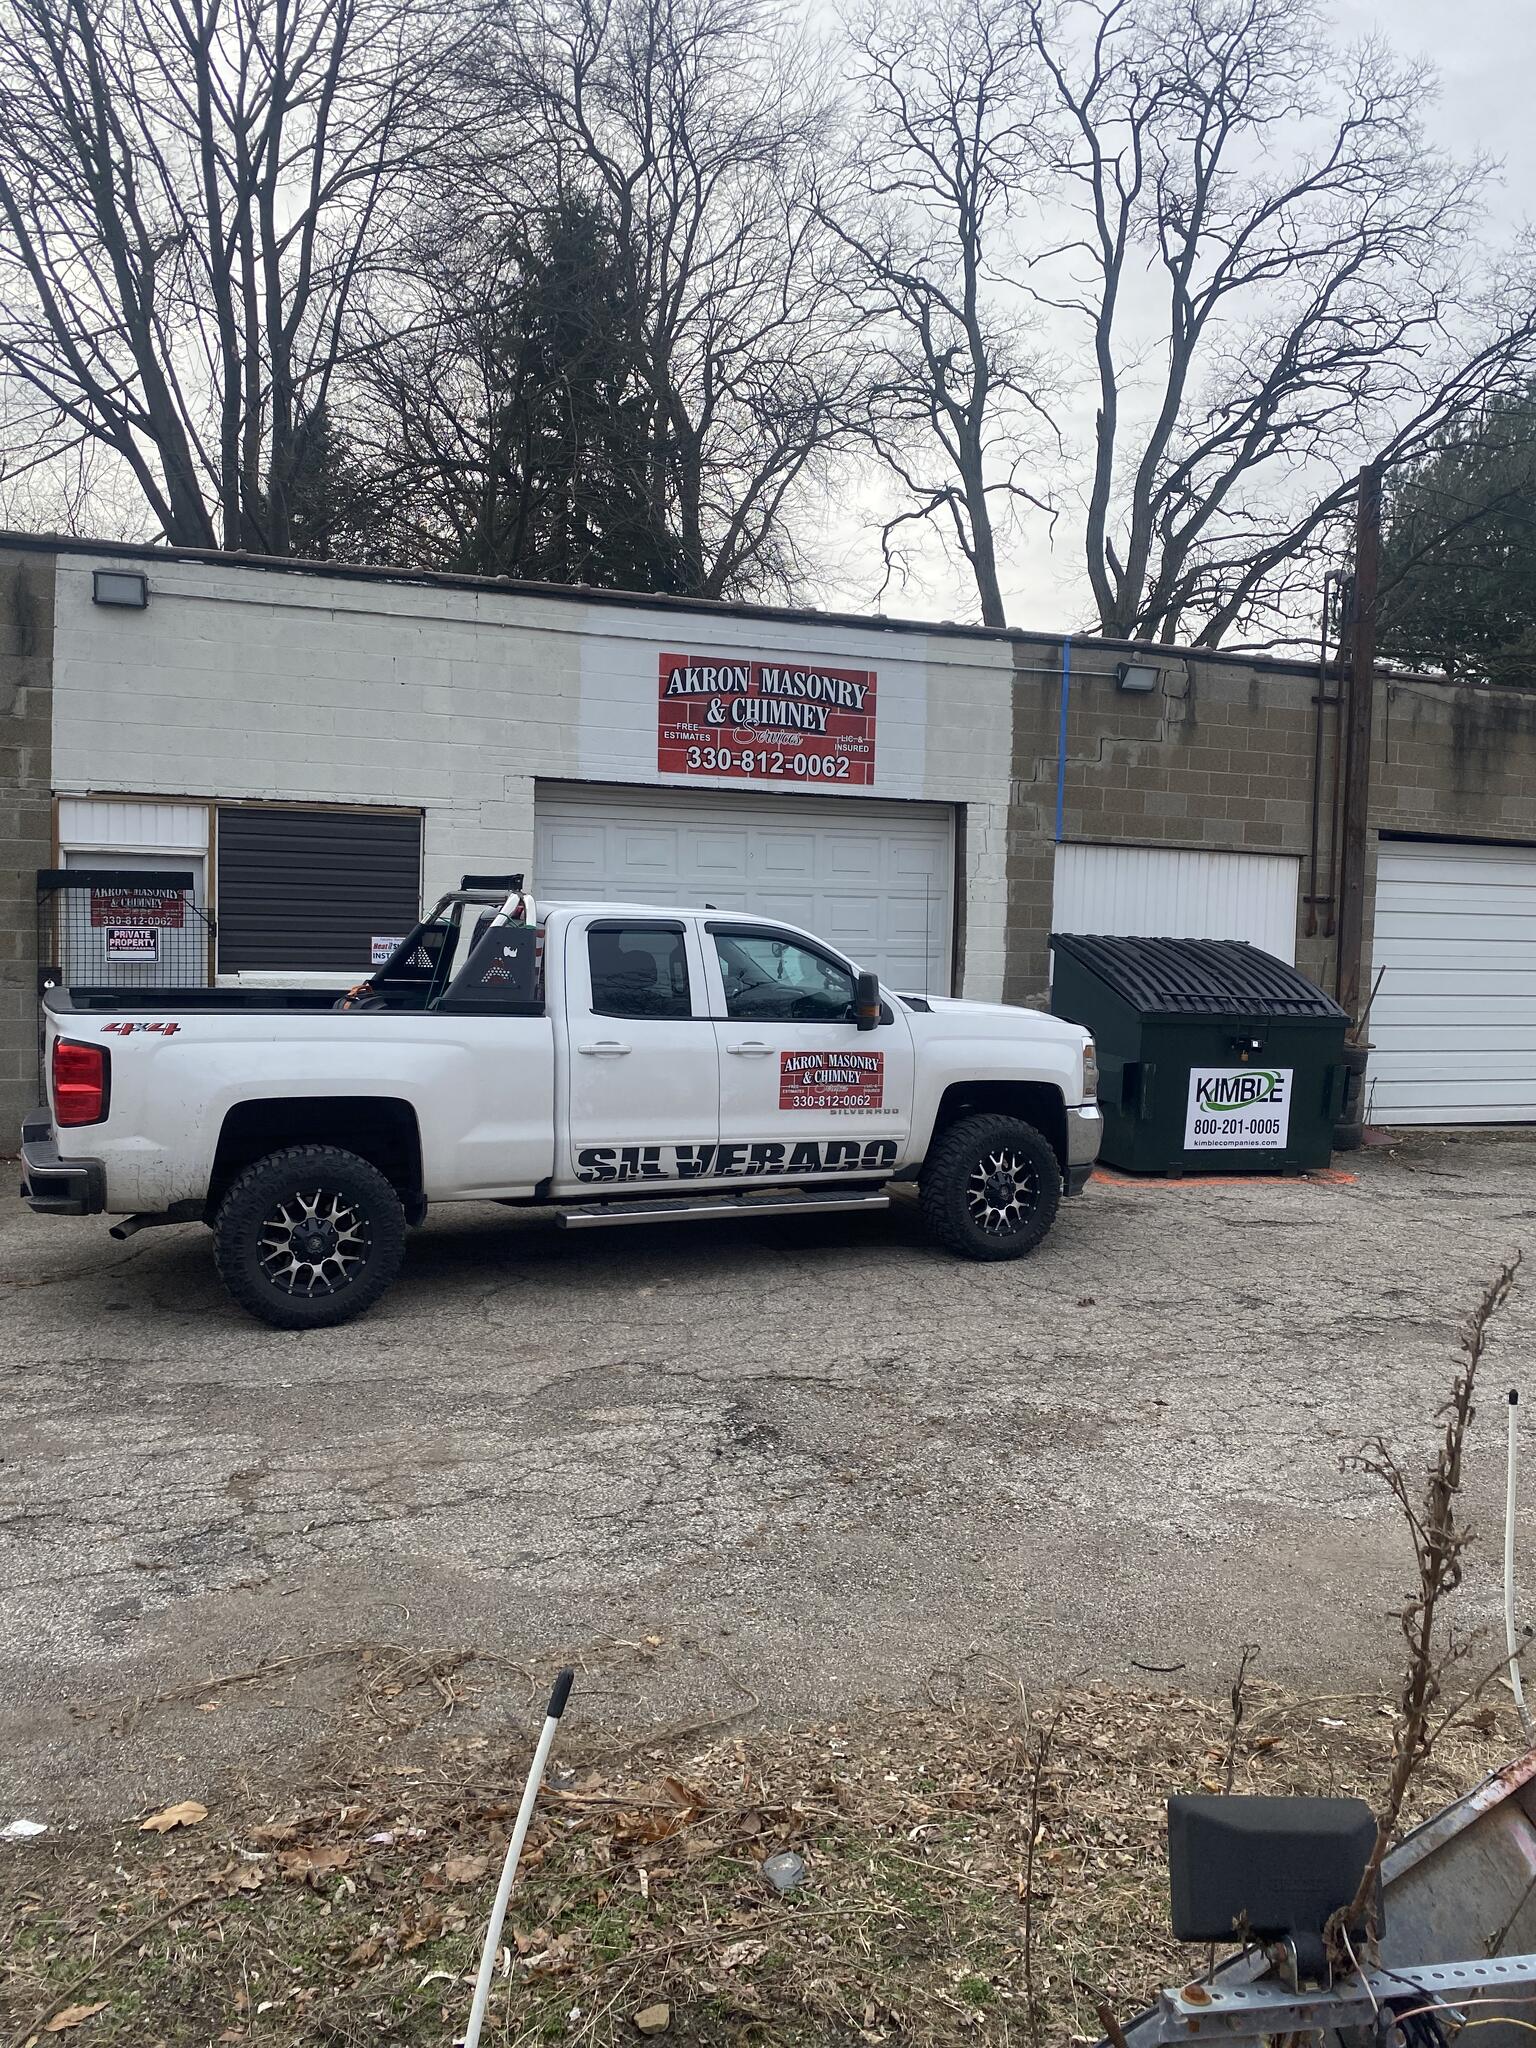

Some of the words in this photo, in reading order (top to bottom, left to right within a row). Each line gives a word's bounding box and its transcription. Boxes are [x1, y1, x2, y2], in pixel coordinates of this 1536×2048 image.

[666, 666, 750, 696] AKRON
[760, 667, 868, 710] MASONRY
[706, 698, 726, 724] &
[731, 698, 831, 732] CHIMNEY
[676, 722, 699, 731] FREE
[664, 731, 711, 742] ESTIMATES
[834, 743, 870, 753] INSURED
[686, 746, 850, 778] 330-812-0062
[121, 898, 163, 909] CHIMNEY
[103, 915, 173, 926] 330-812-0062
[114, 930, 151, 939] PRIVATE
[109, 938, 155, 947] PROPERTY
[784, 1055, 824, 1072] AKRON
[828, 1054, 880, 1072] MASONRY
[802, 1071, 813, 1085] &
[814, 1069, 861, 1084] CHIMNEY
[1195, 1077, 1285, 1103] KIMBLE
[793, 1095, 871, 1107] 330-812-0062
[1194, 1118, 1280, 1135] 800-201-0005
[1193, 1139, 1278, 1147] kimblecompanies.com
[577, 1139, 898, 1184] SILVERADO
